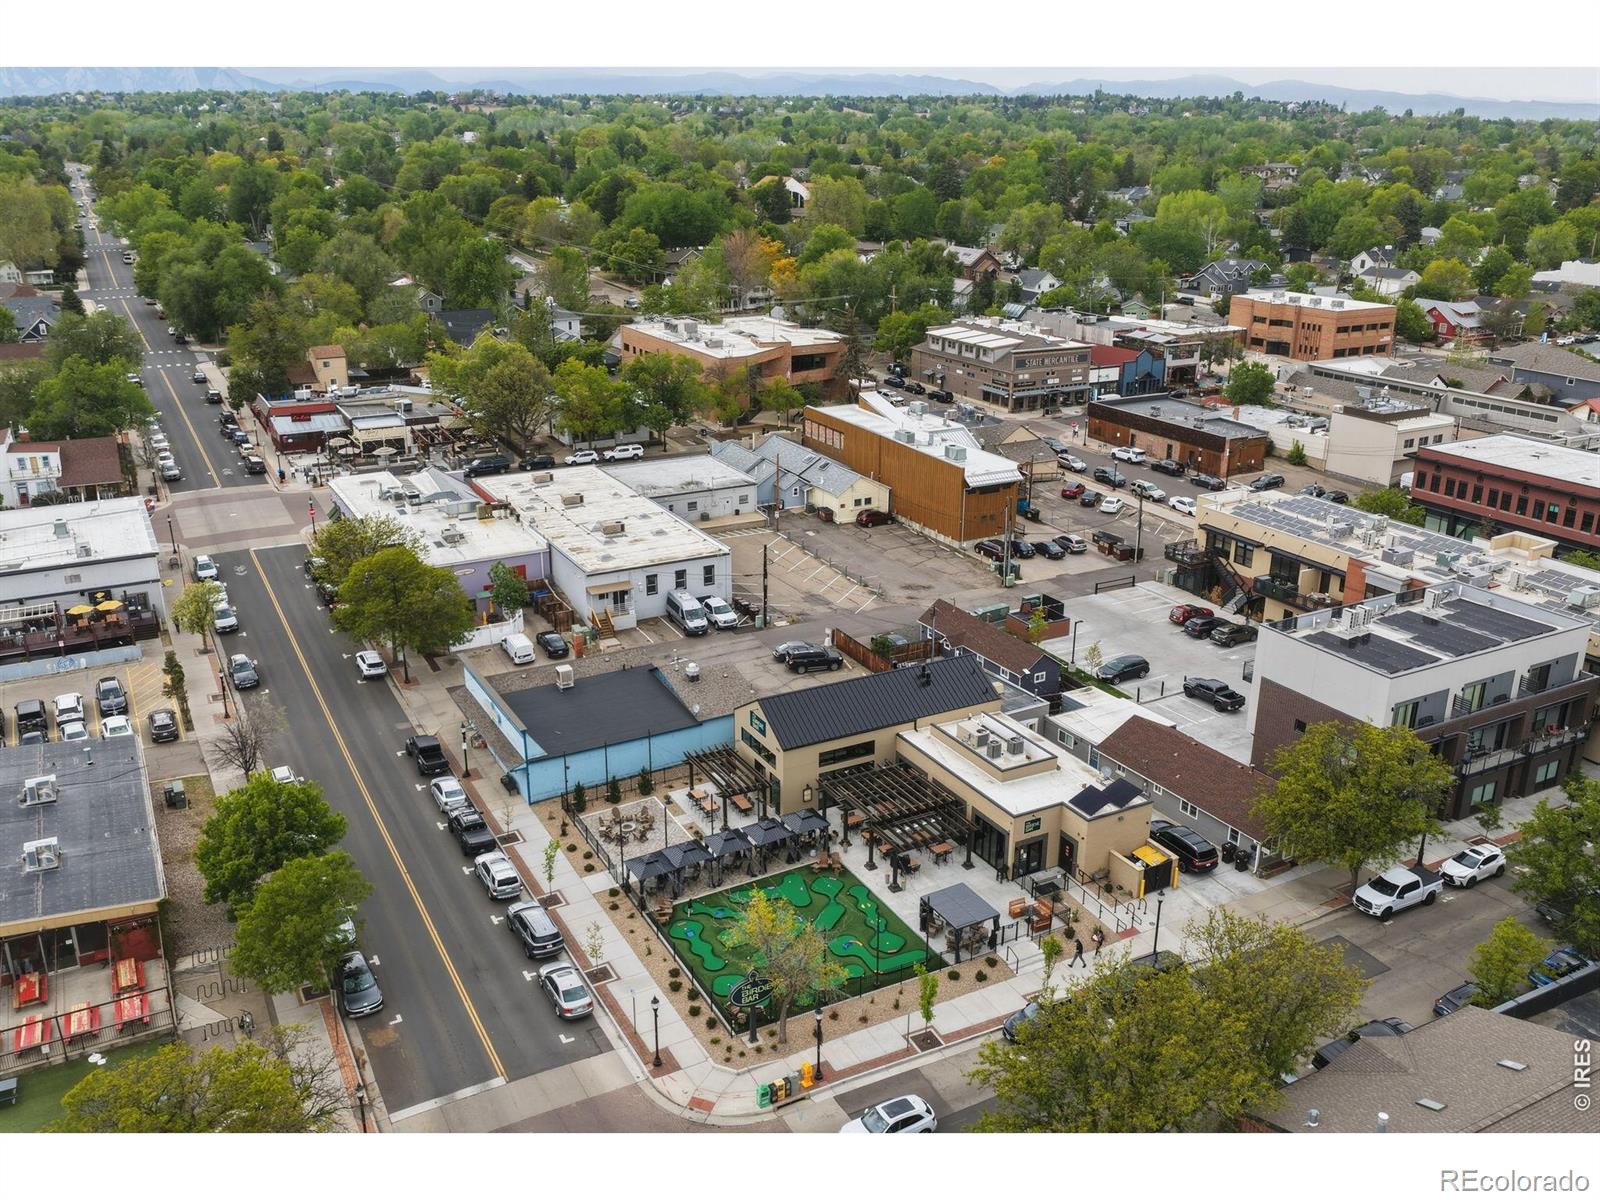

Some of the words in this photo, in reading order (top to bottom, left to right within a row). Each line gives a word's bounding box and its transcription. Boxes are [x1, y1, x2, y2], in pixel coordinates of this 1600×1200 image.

[1025, 358, 1042, 368] STATE
[1044, 355, 1079, 365] MERCANTILE
[742, 994, 759, 1004] BAR
